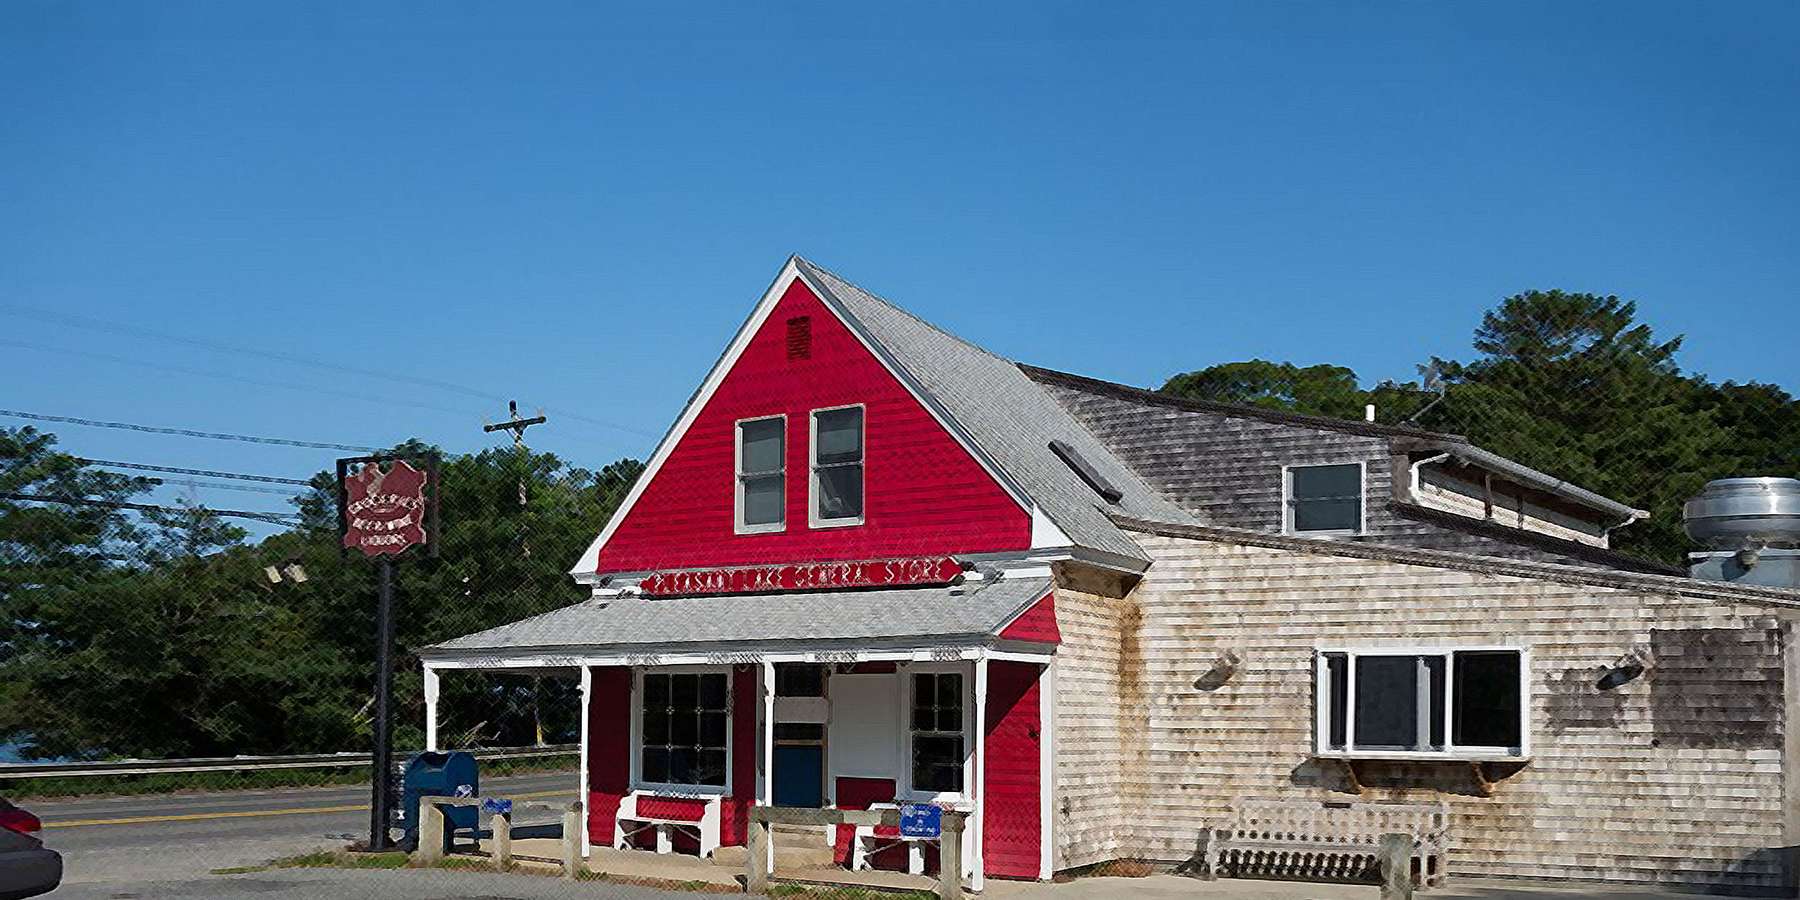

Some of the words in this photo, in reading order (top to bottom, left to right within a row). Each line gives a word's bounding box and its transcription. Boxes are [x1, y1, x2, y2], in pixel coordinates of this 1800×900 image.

[744, 566, 785, 590] LAKE
[795, 562, 872, 587] GENERAL
[885, 558, 945, 581] STORE
